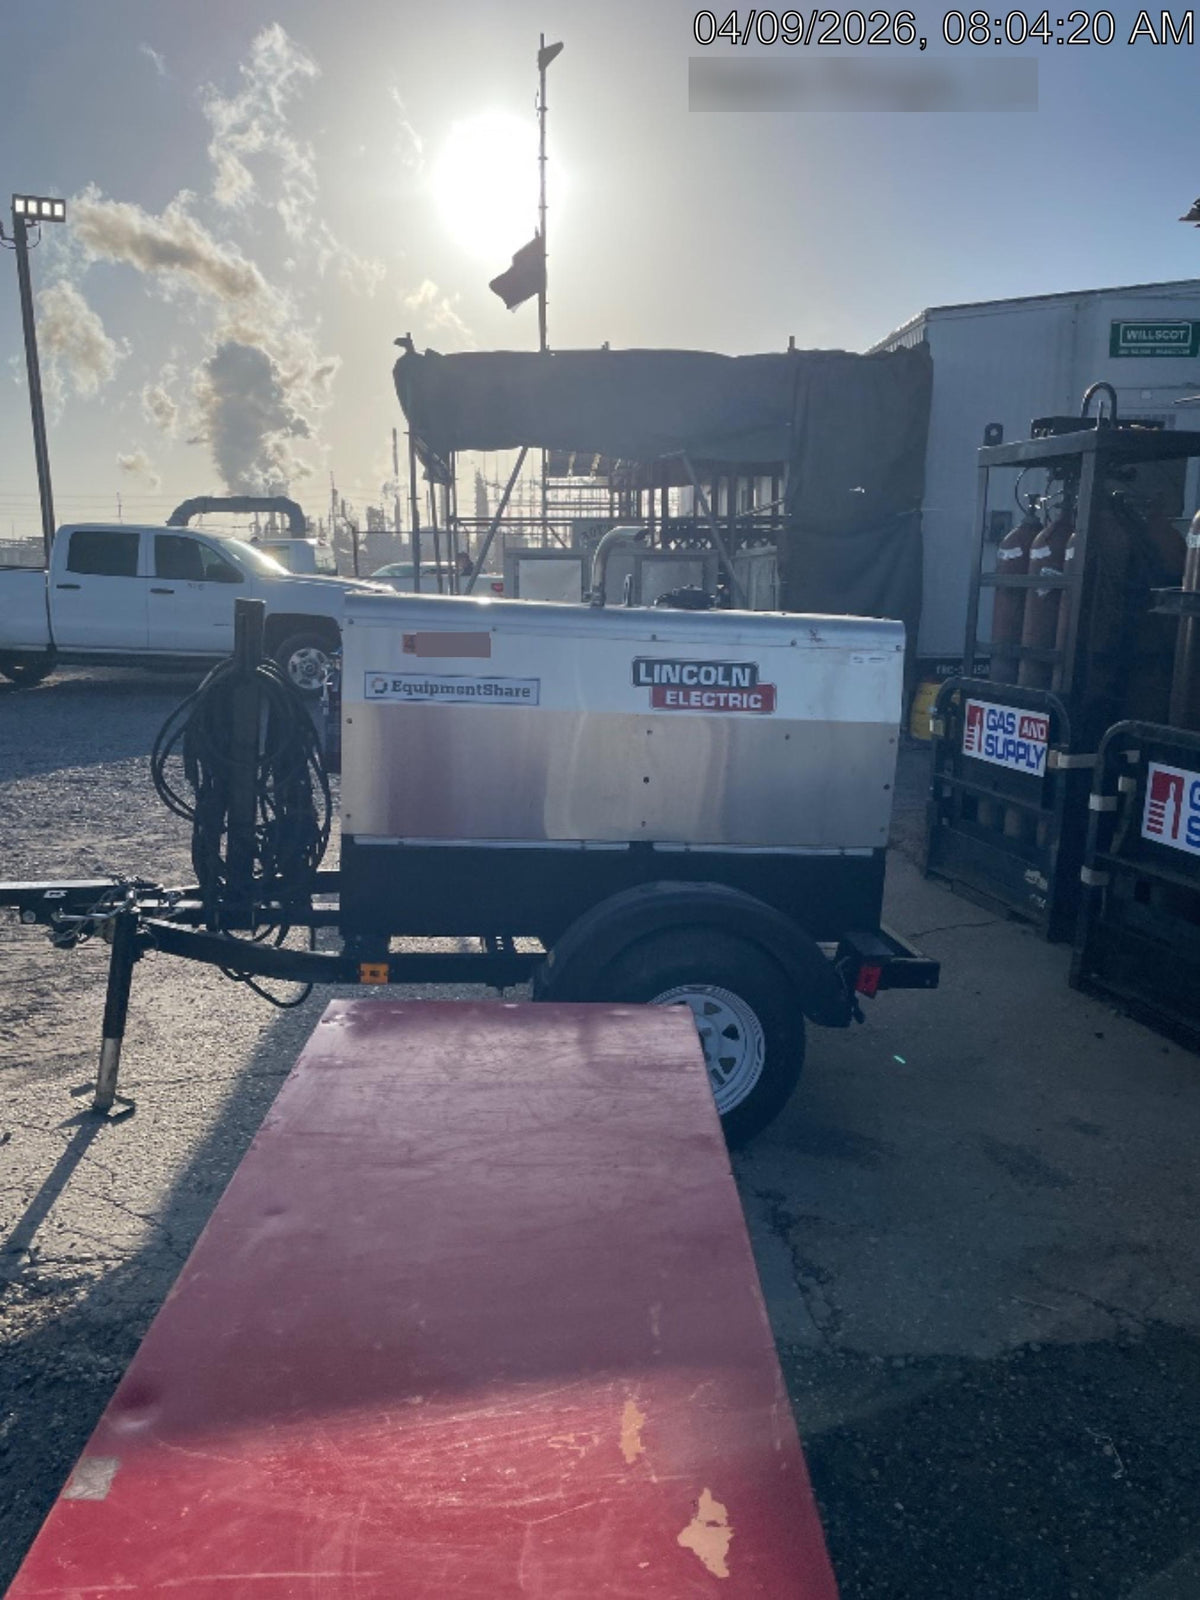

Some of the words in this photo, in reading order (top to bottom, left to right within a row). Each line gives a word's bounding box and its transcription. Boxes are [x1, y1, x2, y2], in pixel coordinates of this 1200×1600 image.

[1126, 330, 1187, 340] WILLSCOT
[638, 662, 752, 687] LINCOLN
[390, 680, 531, 698] EquipmentShare
[665, 690, 763, 709] ELECTRIC
[986, 709, 1016, 735] GAS
[1021, 719, 1047, 740] AND
[985, 733, 1046, 770] SUPPLY
